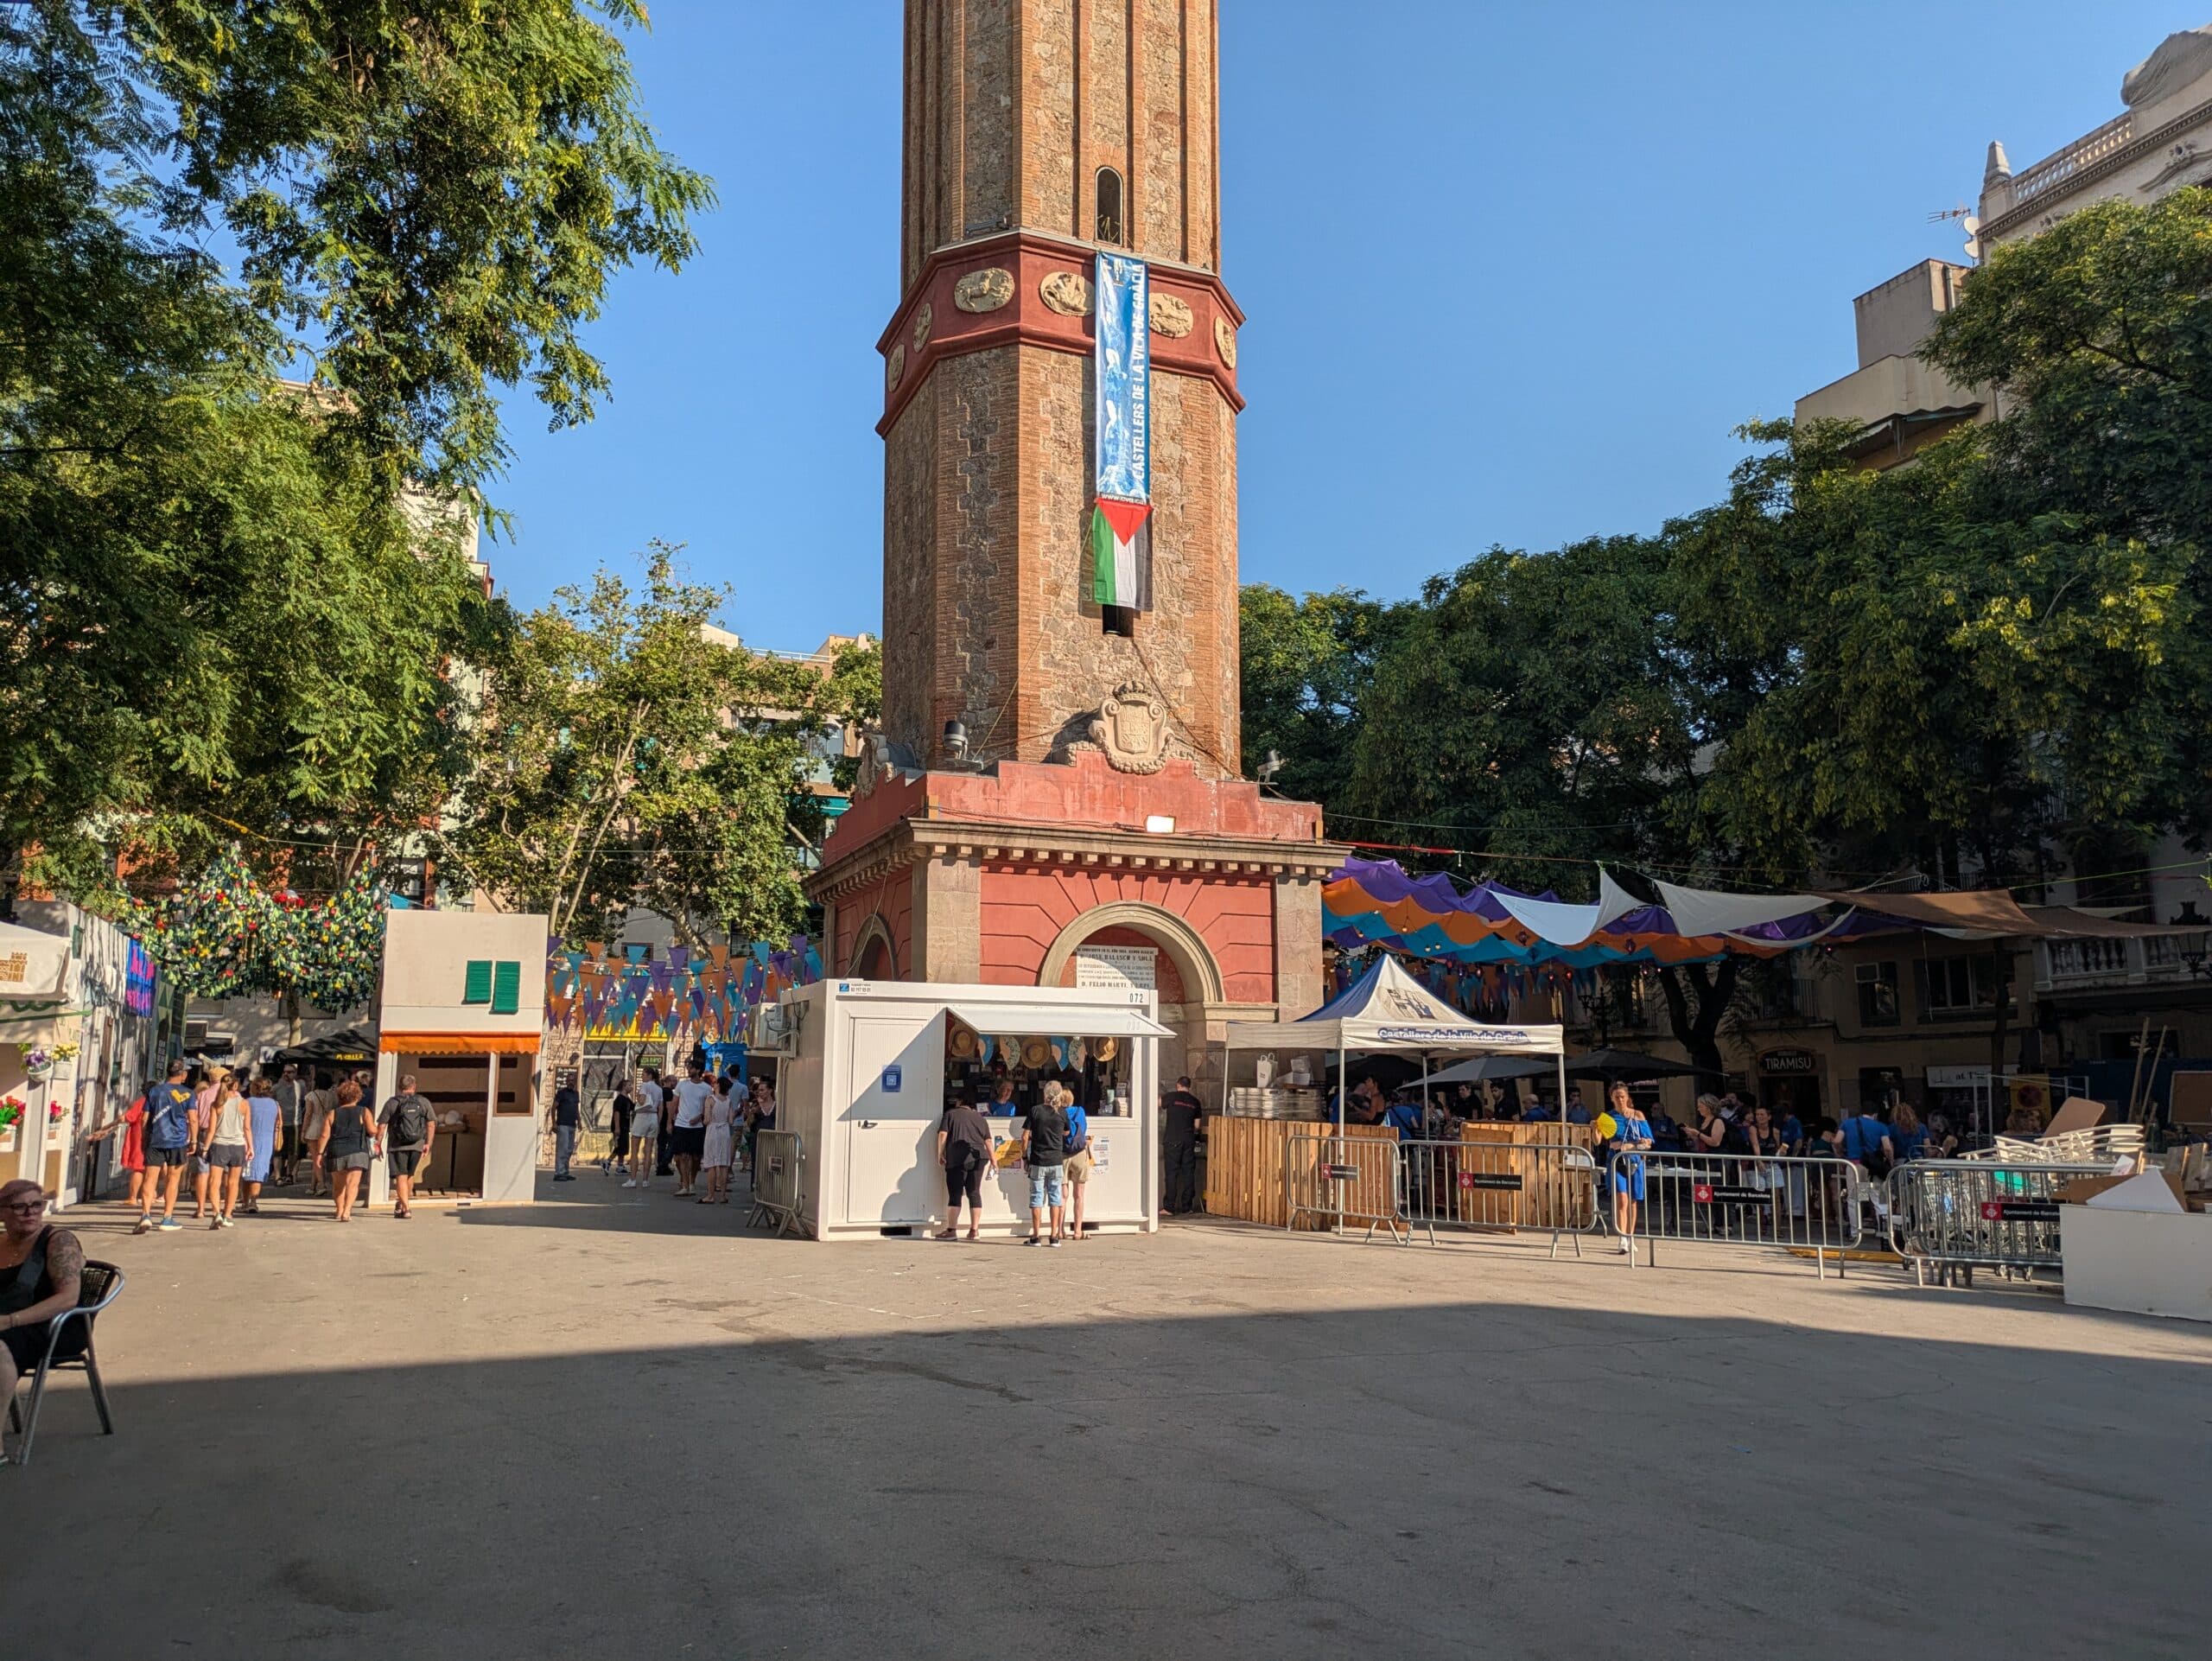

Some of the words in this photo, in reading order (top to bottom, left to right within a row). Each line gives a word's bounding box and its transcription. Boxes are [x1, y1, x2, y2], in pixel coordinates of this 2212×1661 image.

[1128, 264, 1146, 310] GRÀCIA
[1131, 313, 1146, 329] DE
[1131, 332, 1146, 360] VILA
[1131, 365, 1146, 382] LA
[1131, 385, 1146, 401] DE
[1131, 403, 1146, 480] CASTELLERS
[1129, 993, 1143, 1002] 072
[1764, 1057, 1812, 1070] TIRAMISU
